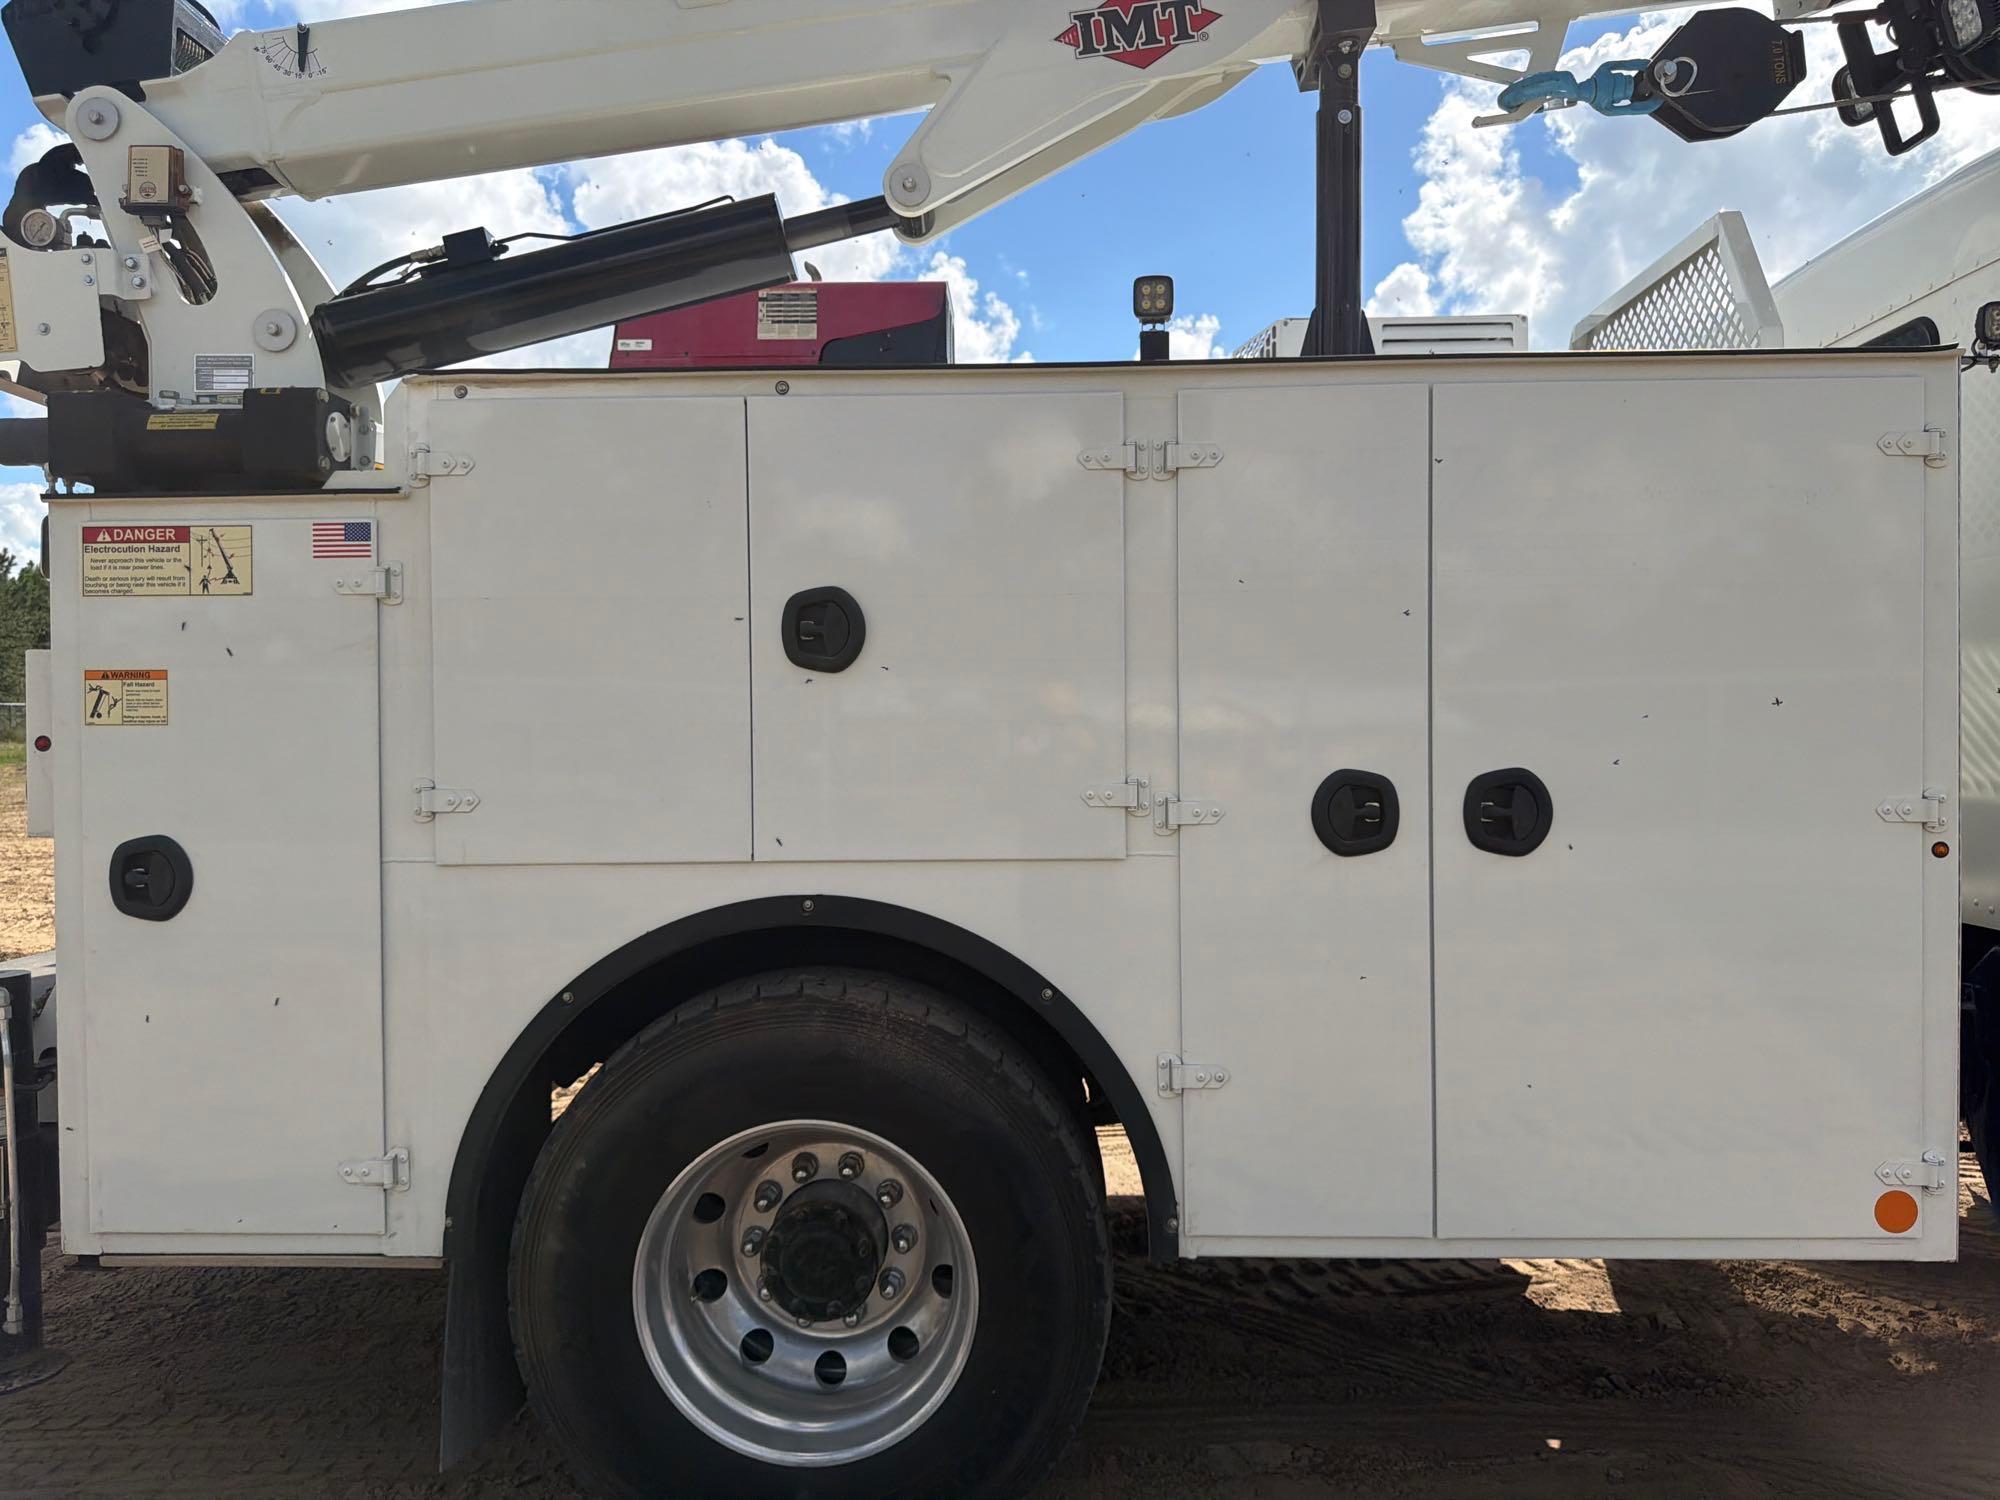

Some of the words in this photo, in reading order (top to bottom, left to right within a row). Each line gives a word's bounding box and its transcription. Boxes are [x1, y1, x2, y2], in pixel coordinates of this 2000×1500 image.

[1774, 55, 1786, 84] TONS
[113, 529, 176, 541] DANGER
[84, 545, 146, 554] Electrocution
[148, 545, 180, 553] Hazard
[111, 671, 151, 679] WARNING
